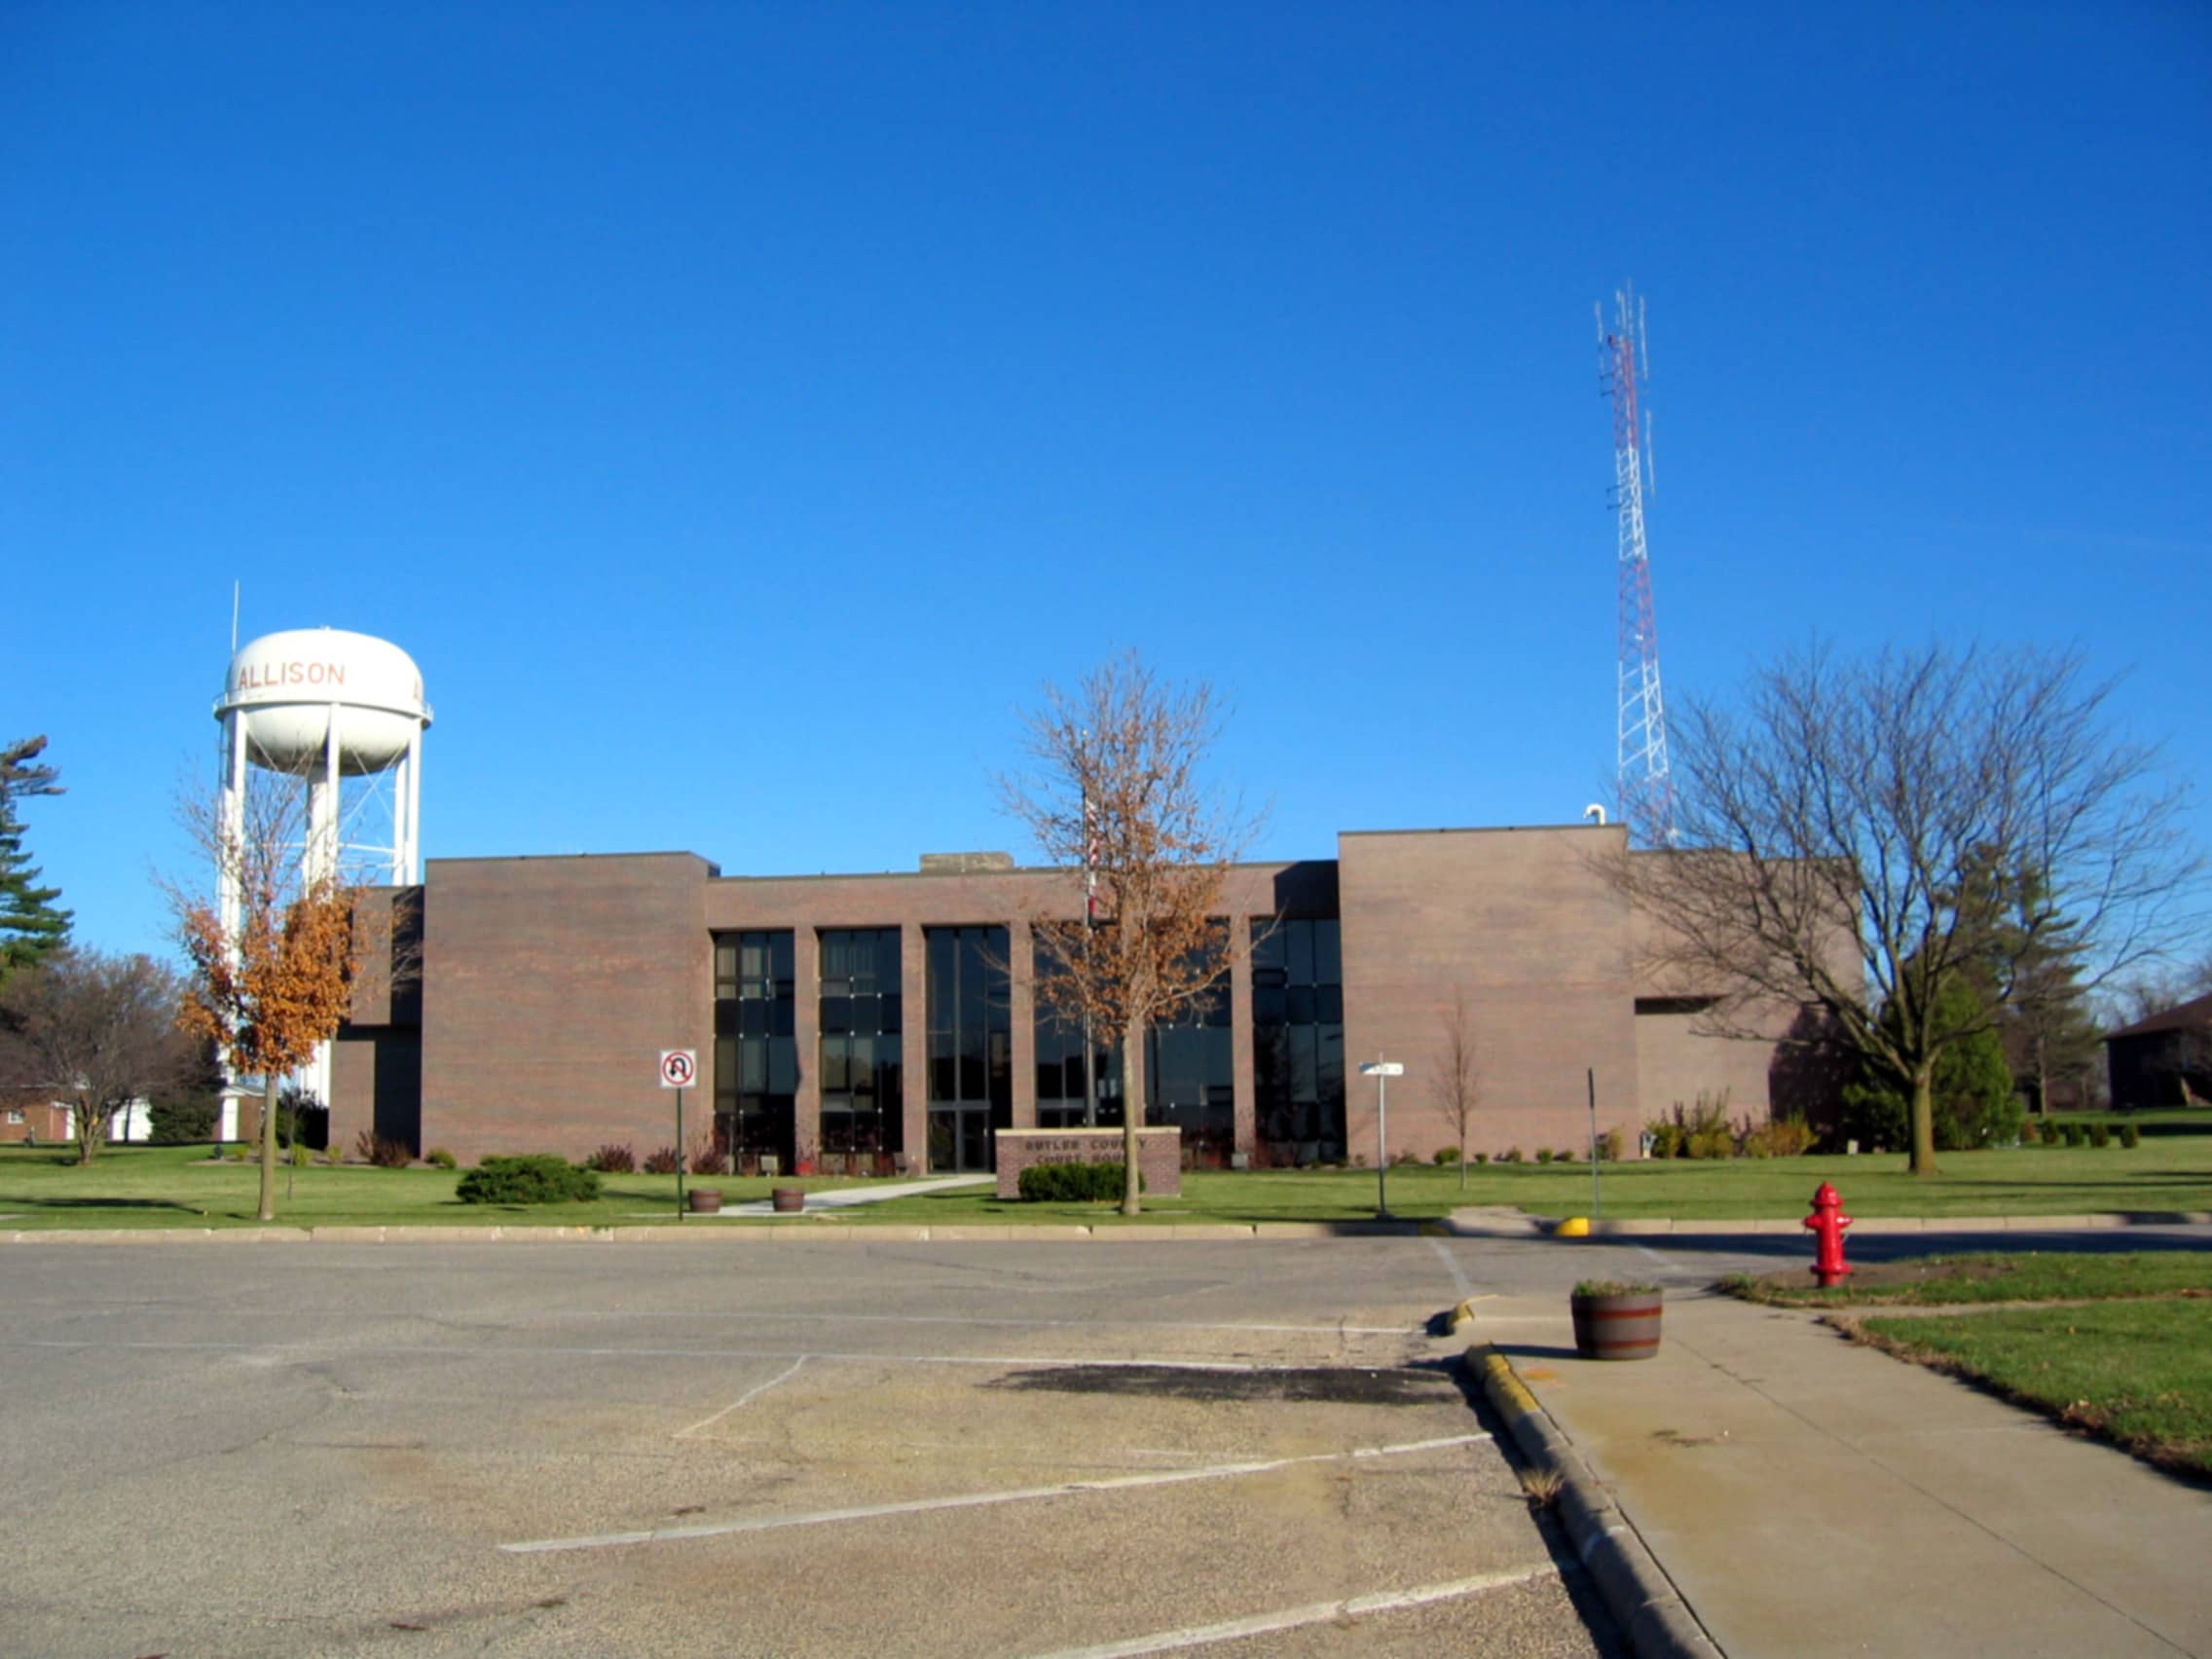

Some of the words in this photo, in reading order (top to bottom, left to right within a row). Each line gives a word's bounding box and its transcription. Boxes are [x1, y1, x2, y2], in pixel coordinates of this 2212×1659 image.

[239, 662, 345, 687] ALLISON
[1025, 1139, 1079, 1151] BUTLER
[1090, 1138, 1147, 1150] COUY
